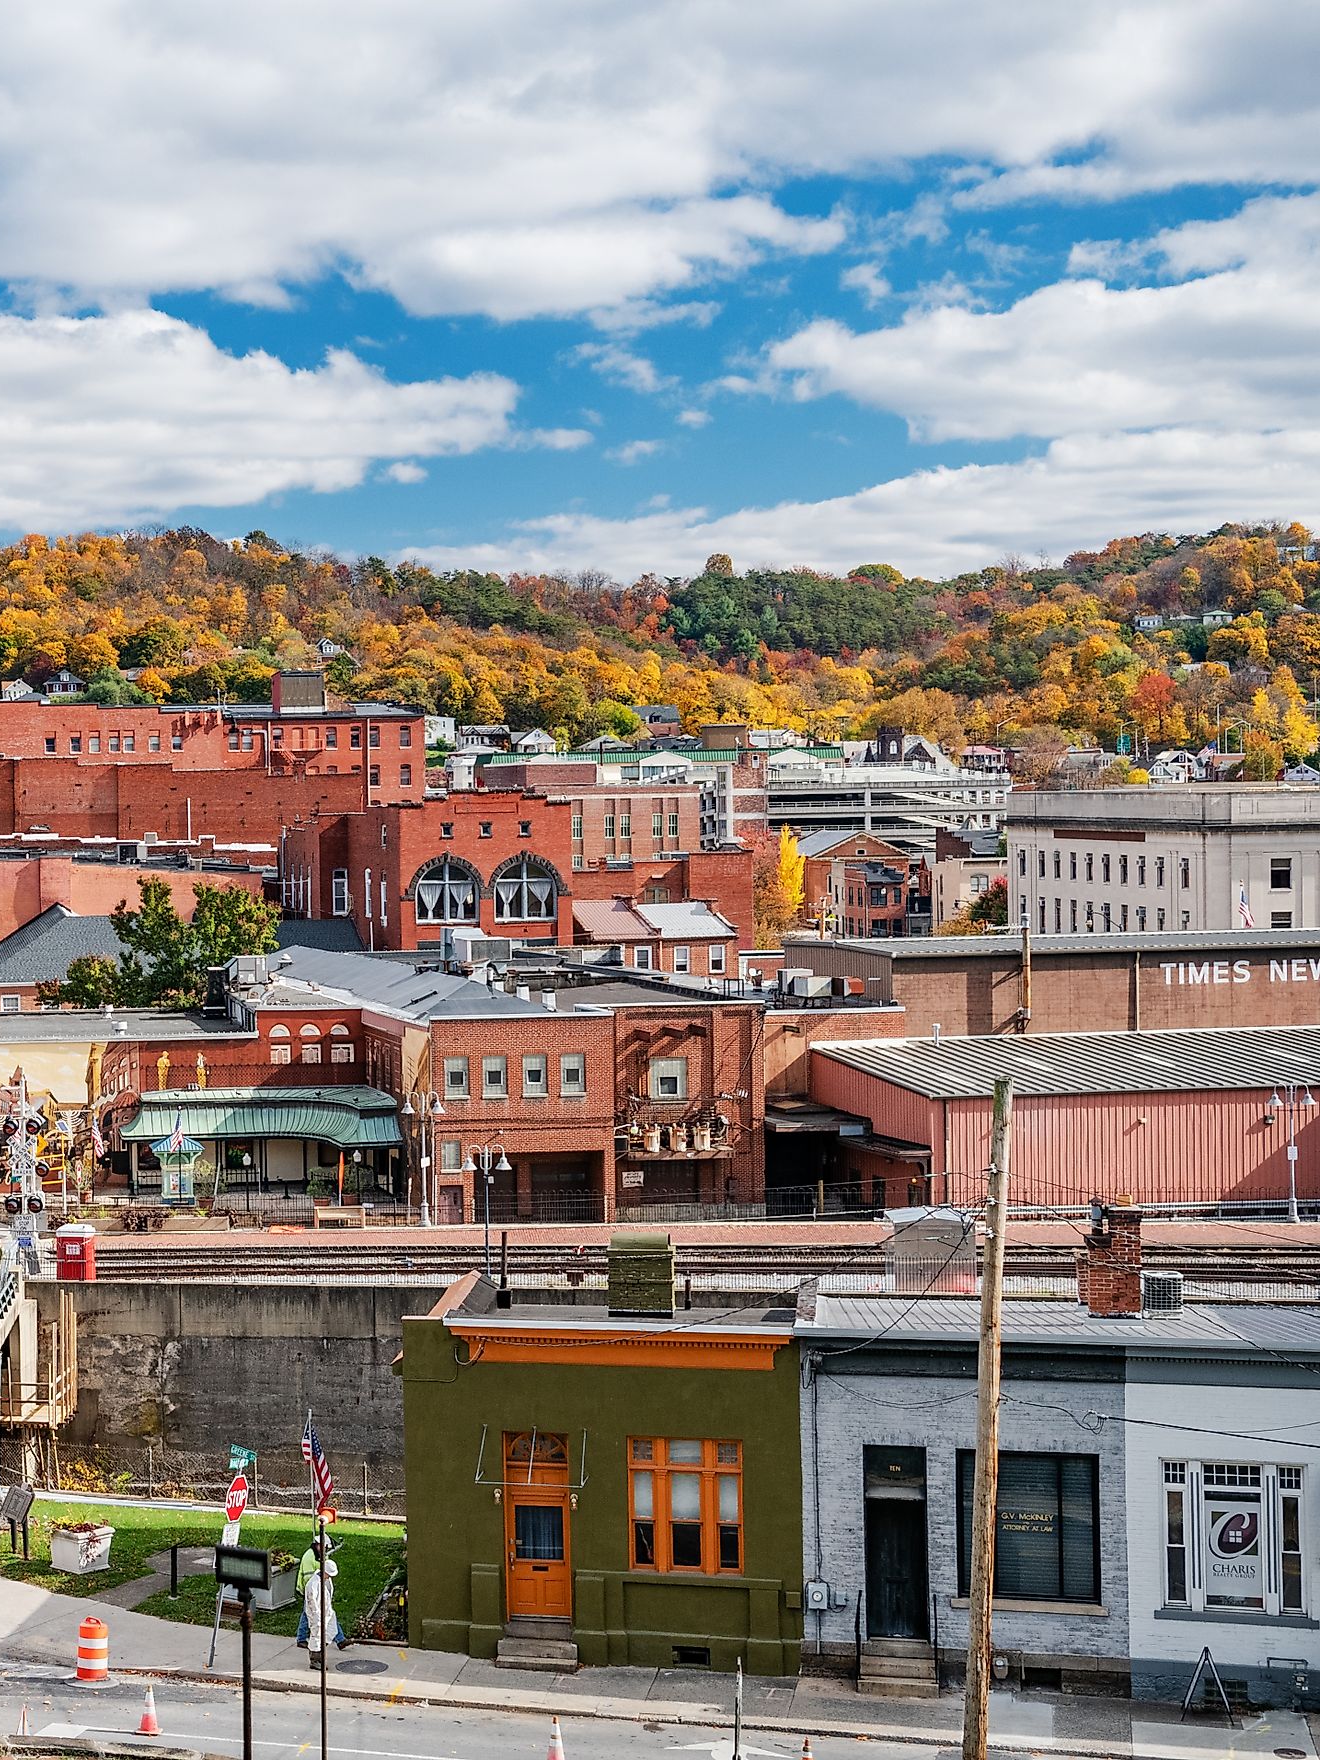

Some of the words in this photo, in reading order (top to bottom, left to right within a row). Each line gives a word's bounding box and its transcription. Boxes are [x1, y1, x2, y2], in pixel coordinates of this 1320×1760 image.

[1160, 960, 1250, 984] TIMES
[8, 1138, 36, 1166] CROSSING
[231, 1445, 248, 1458] GREENE
[227, 1489, 247, 1508] STOP
[1018, 1513, 1054, 1521] McKINLEY
[1212, 1564, 1256, 1574] CHARIS
